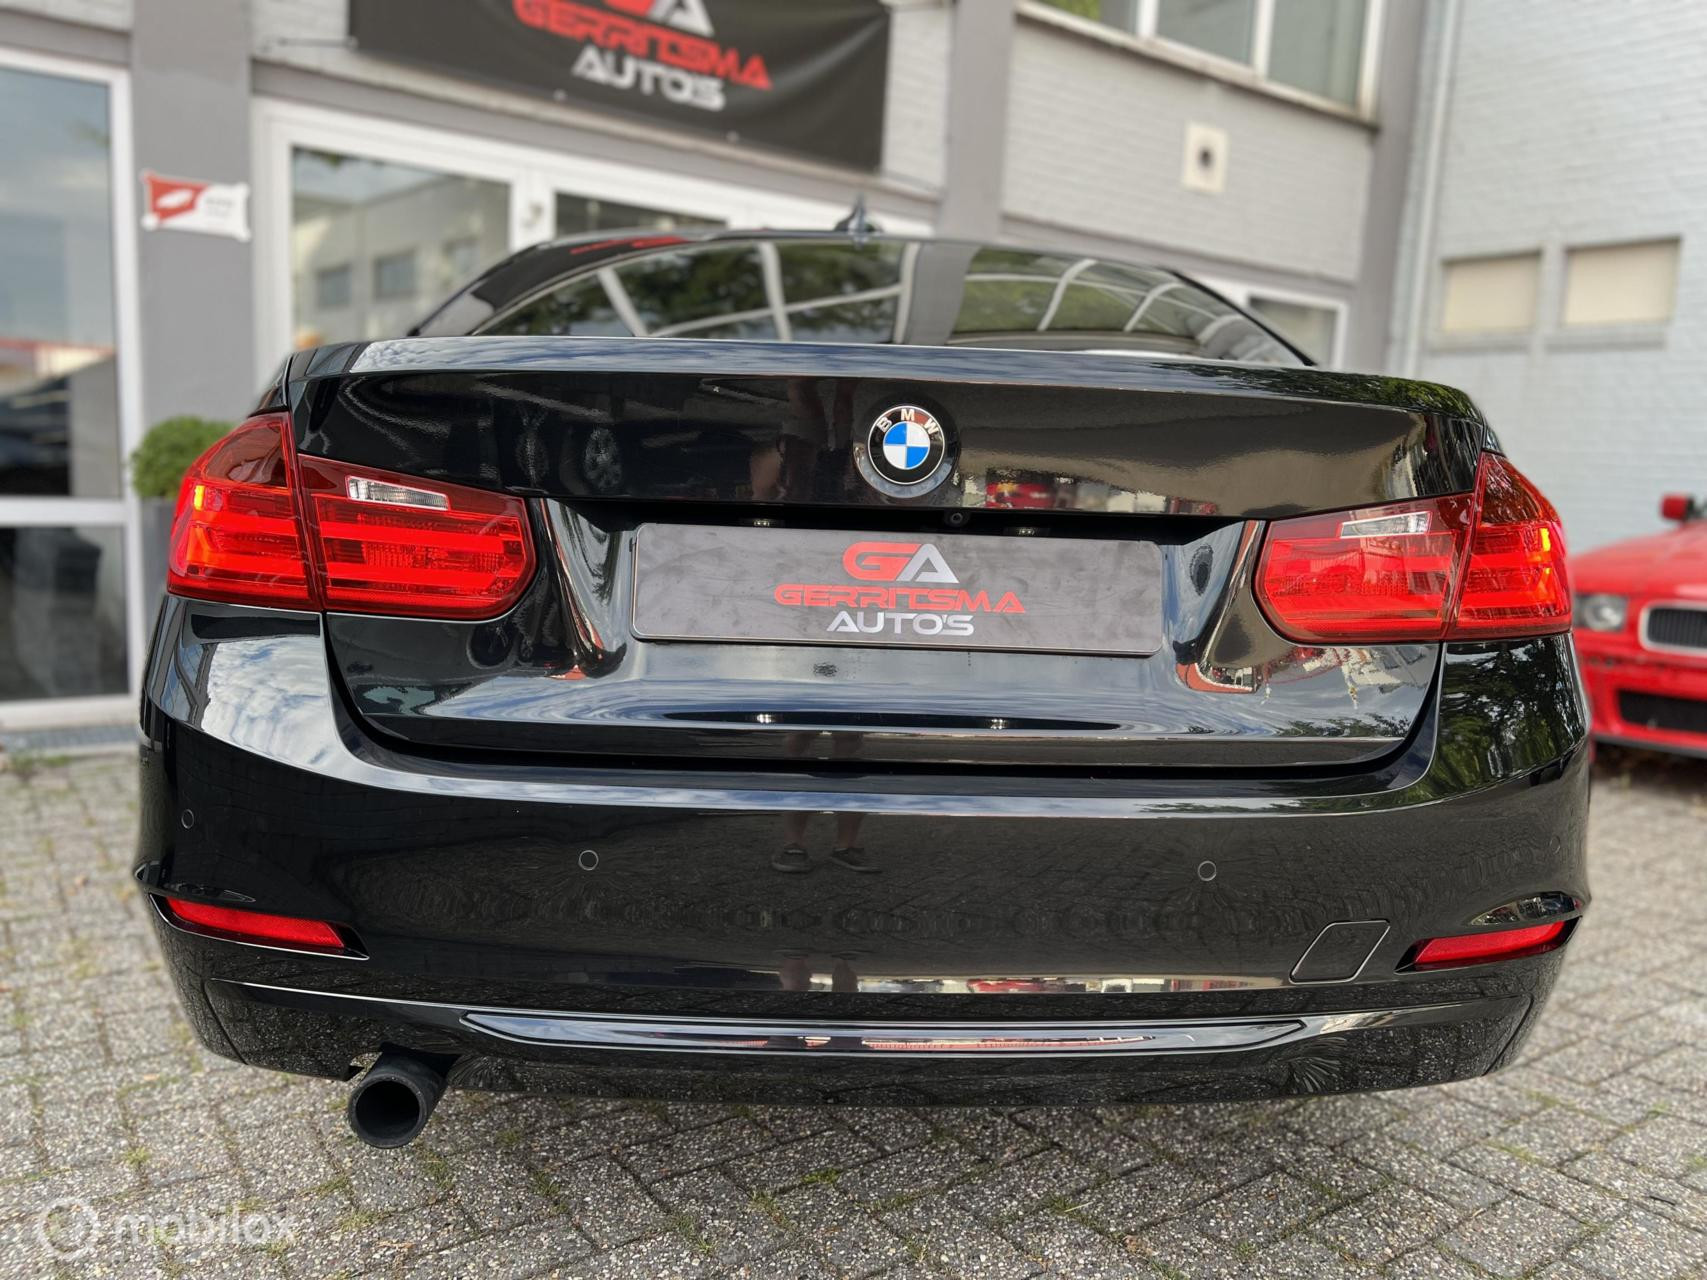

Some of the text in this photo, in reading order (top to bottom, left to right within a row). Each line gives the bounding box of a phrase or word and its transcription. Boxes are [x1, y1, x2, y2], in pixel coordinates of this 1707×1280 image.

[876, 408, 940, 434] BMW
[842, 541, 959, 583] GA
[774, 584, 1025, 613] GERRITSMA
[826, 611, 974, 636] AUTO'S
